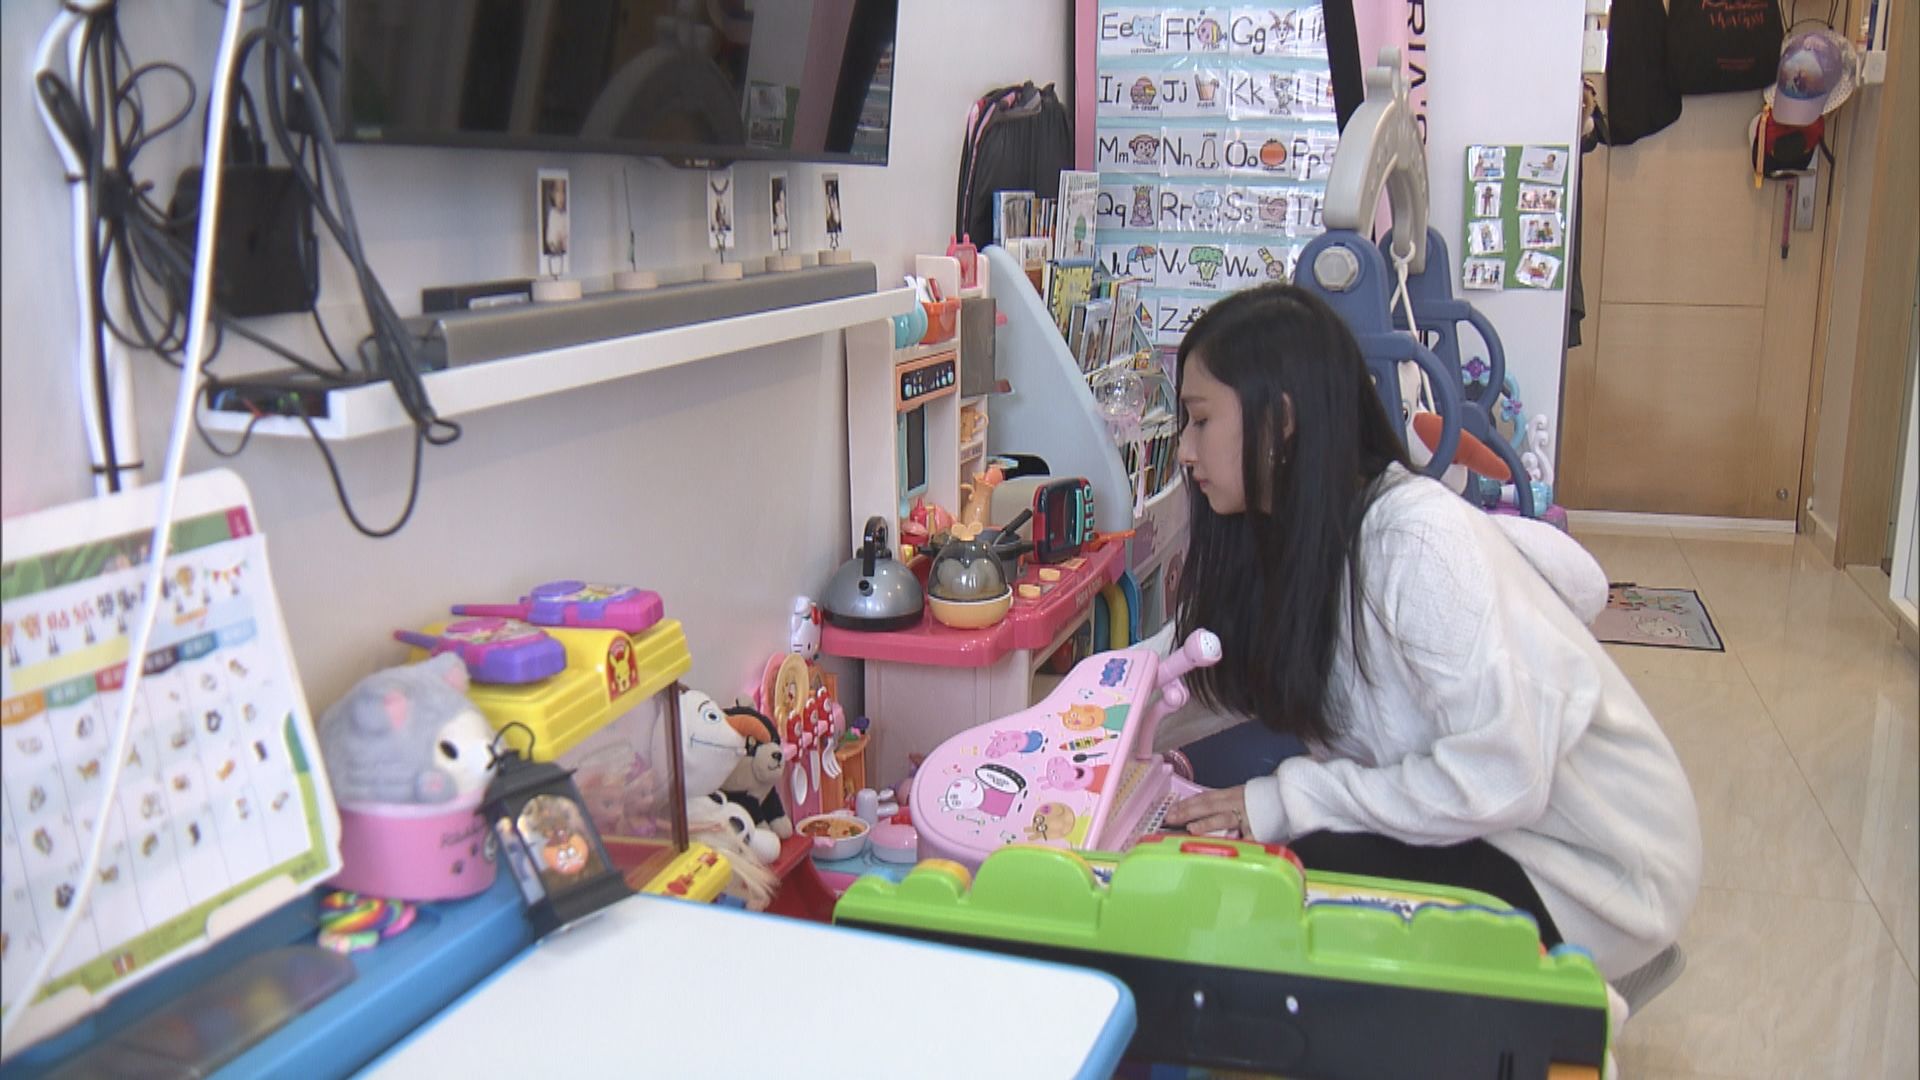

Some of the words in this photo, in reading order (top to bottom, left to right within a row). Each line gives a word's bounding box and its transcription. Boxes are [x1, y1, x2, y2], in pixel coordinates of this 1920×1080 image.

[1101, 12, 1134, 41] Ee
[1165, 17, 1196, 51] Ff
[1231, 16, 1266, 55] Gg
[1099, 75, 1122, 104] Ii
[1162, 80, 1188, 104] Jj
[1229, 75, 1265, 106] Kk
[1098, 136, 1129, 164] Mm
[1162, 136, 1193, 166] Nn
[1225, 140, 1258, 168] Oo
[1292, 138, 1321, 179] Pp
[1097, 191, 1127, 228] Qq
[1160, 191, 1193, 221] Rr
[1224, 191, 1253, 222] Ss
[1290, 194, 1324, 227] Tt
[1159, 247, 1187, 275] Vv
[1224, 255, 1258, 278] Ww
